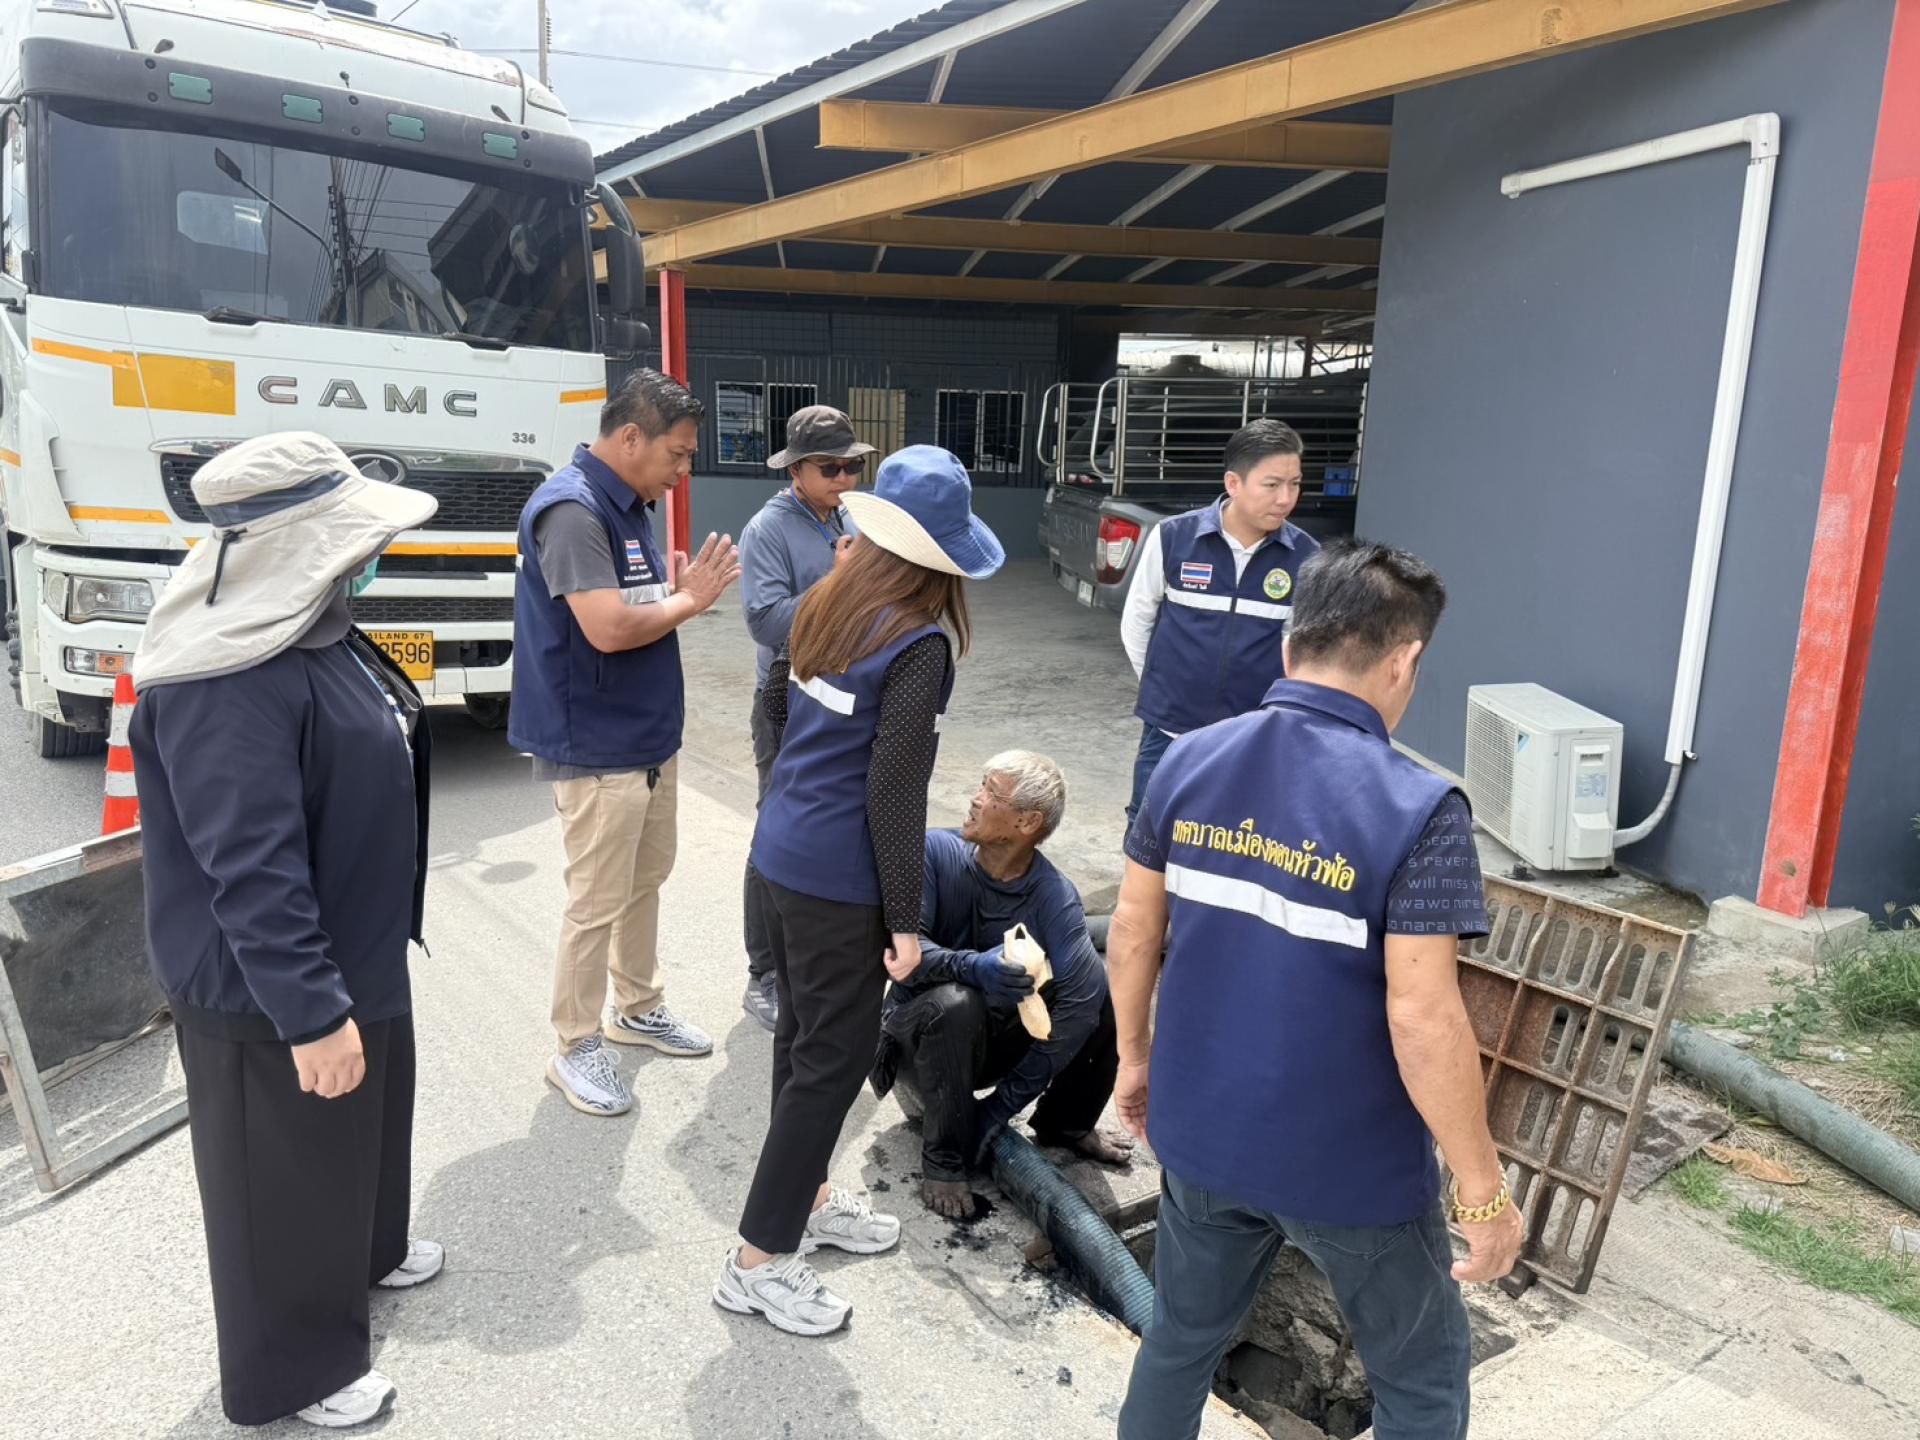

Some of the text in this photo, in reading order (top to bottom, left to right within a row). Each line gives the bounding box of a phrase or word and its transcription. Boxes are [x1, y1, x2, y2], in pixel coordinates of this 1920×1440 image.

[257, 375, 477, 417] CAMC
[511, 432, 536, 444] 336
[414, 632, 425, 640] 67
[1407, 876, 1436, 889] will
